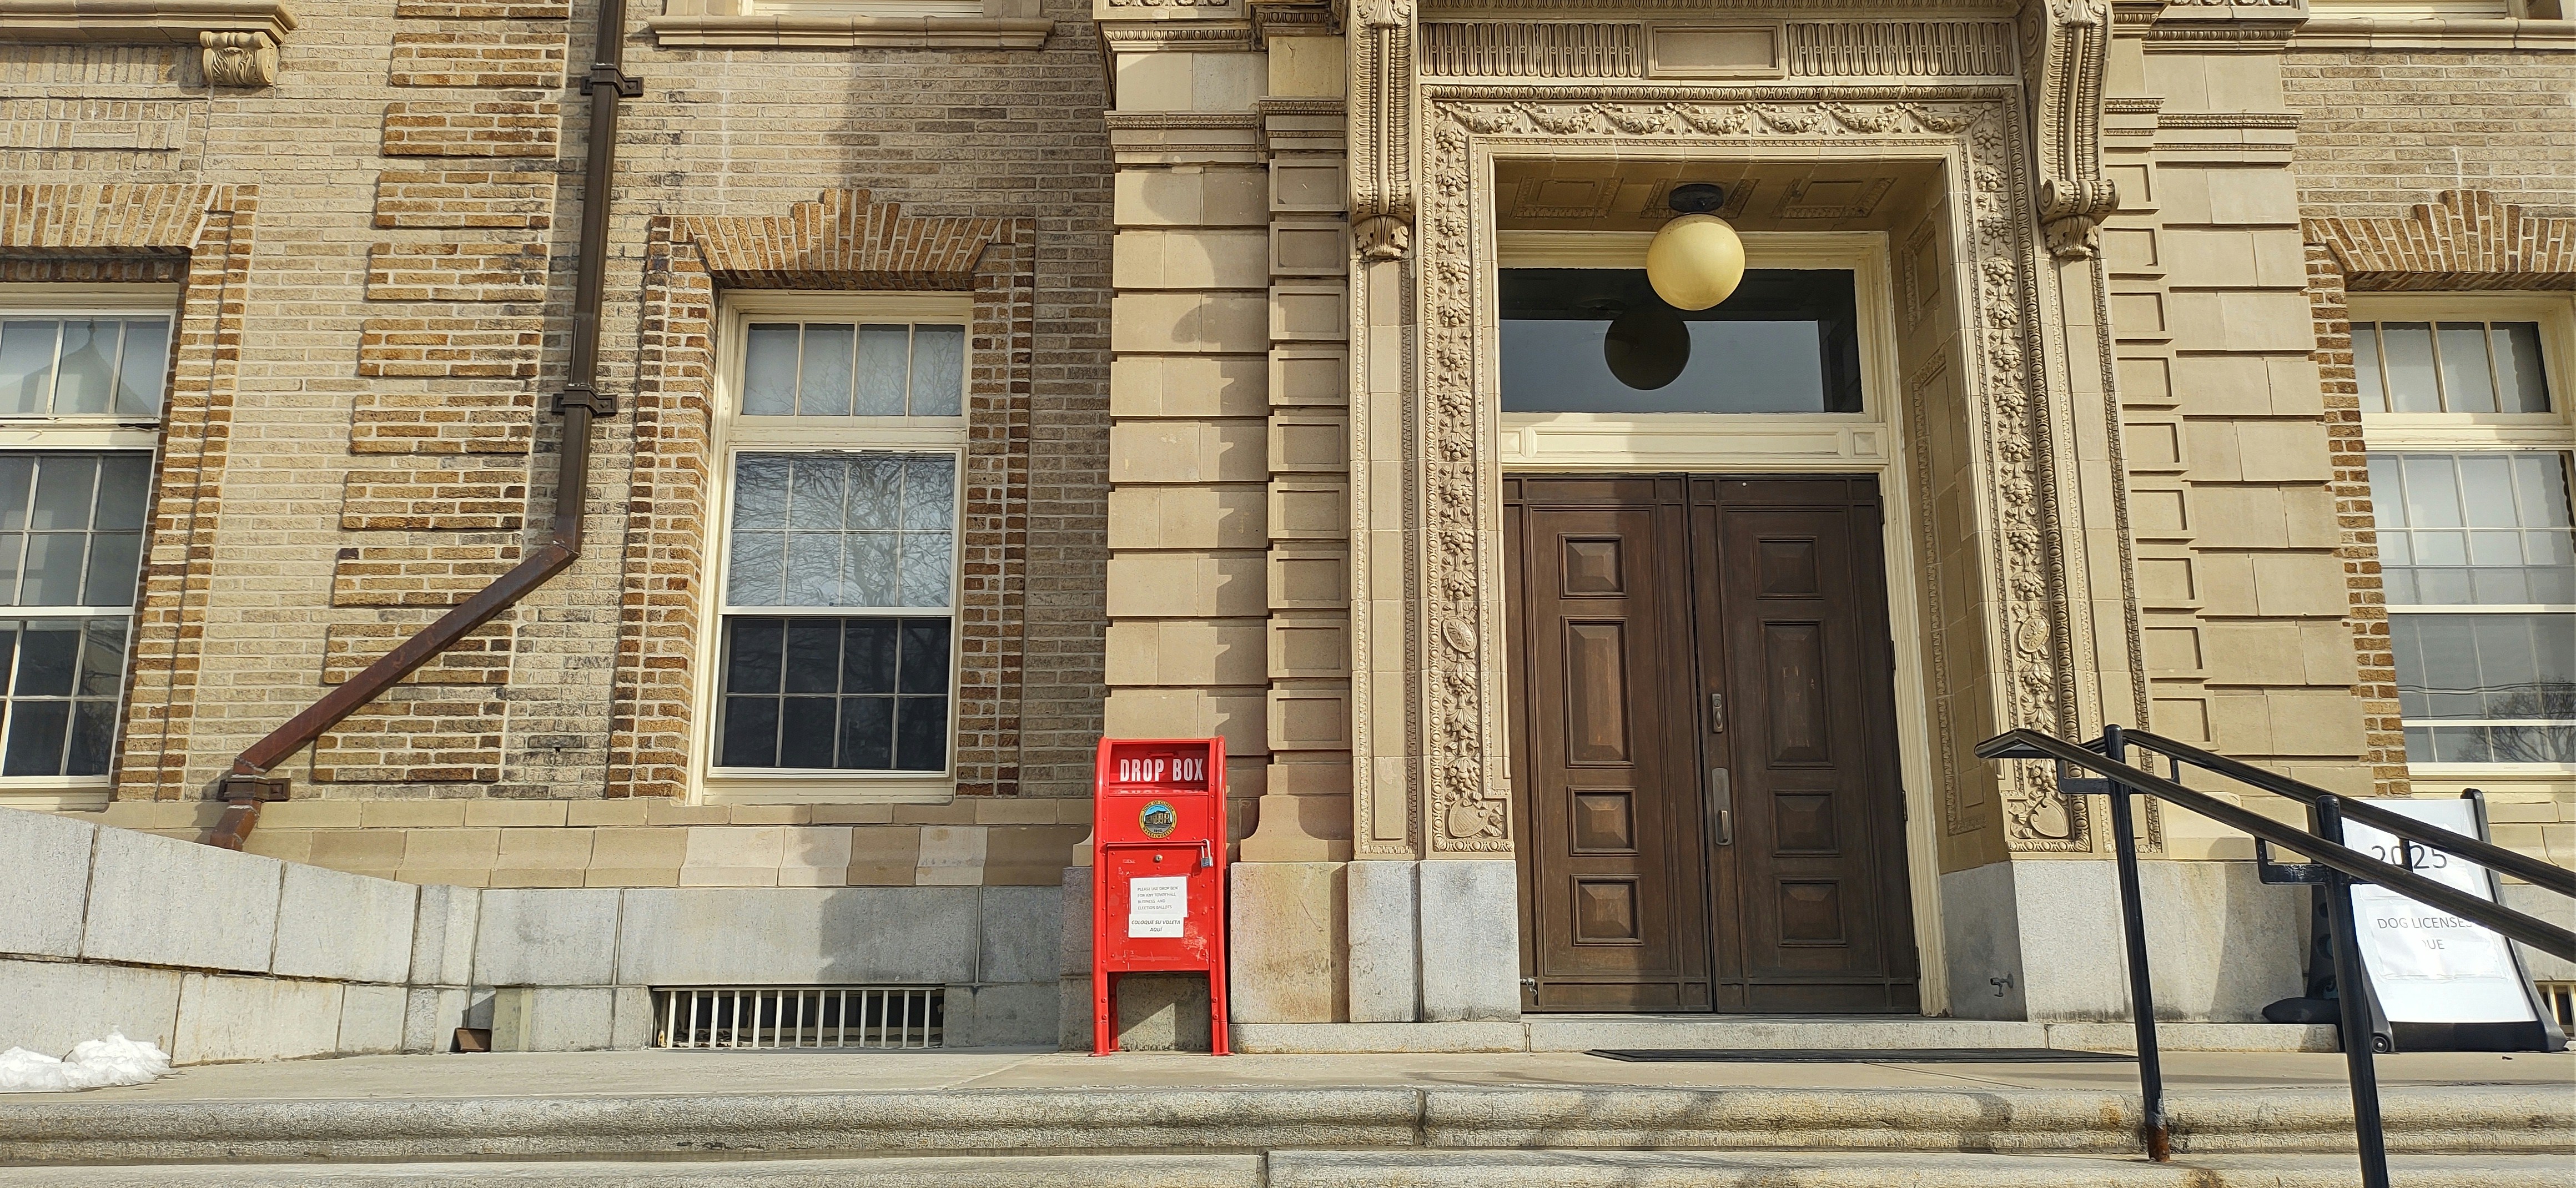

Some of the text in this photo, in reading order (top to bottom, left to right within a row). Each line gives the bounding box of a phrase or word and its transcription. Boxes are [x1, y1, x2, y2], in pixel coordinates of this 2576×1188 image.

[1120, 758, 1204, 782] DROP BOX
[2377, 917, 2472, 929] DOG LICENSE
